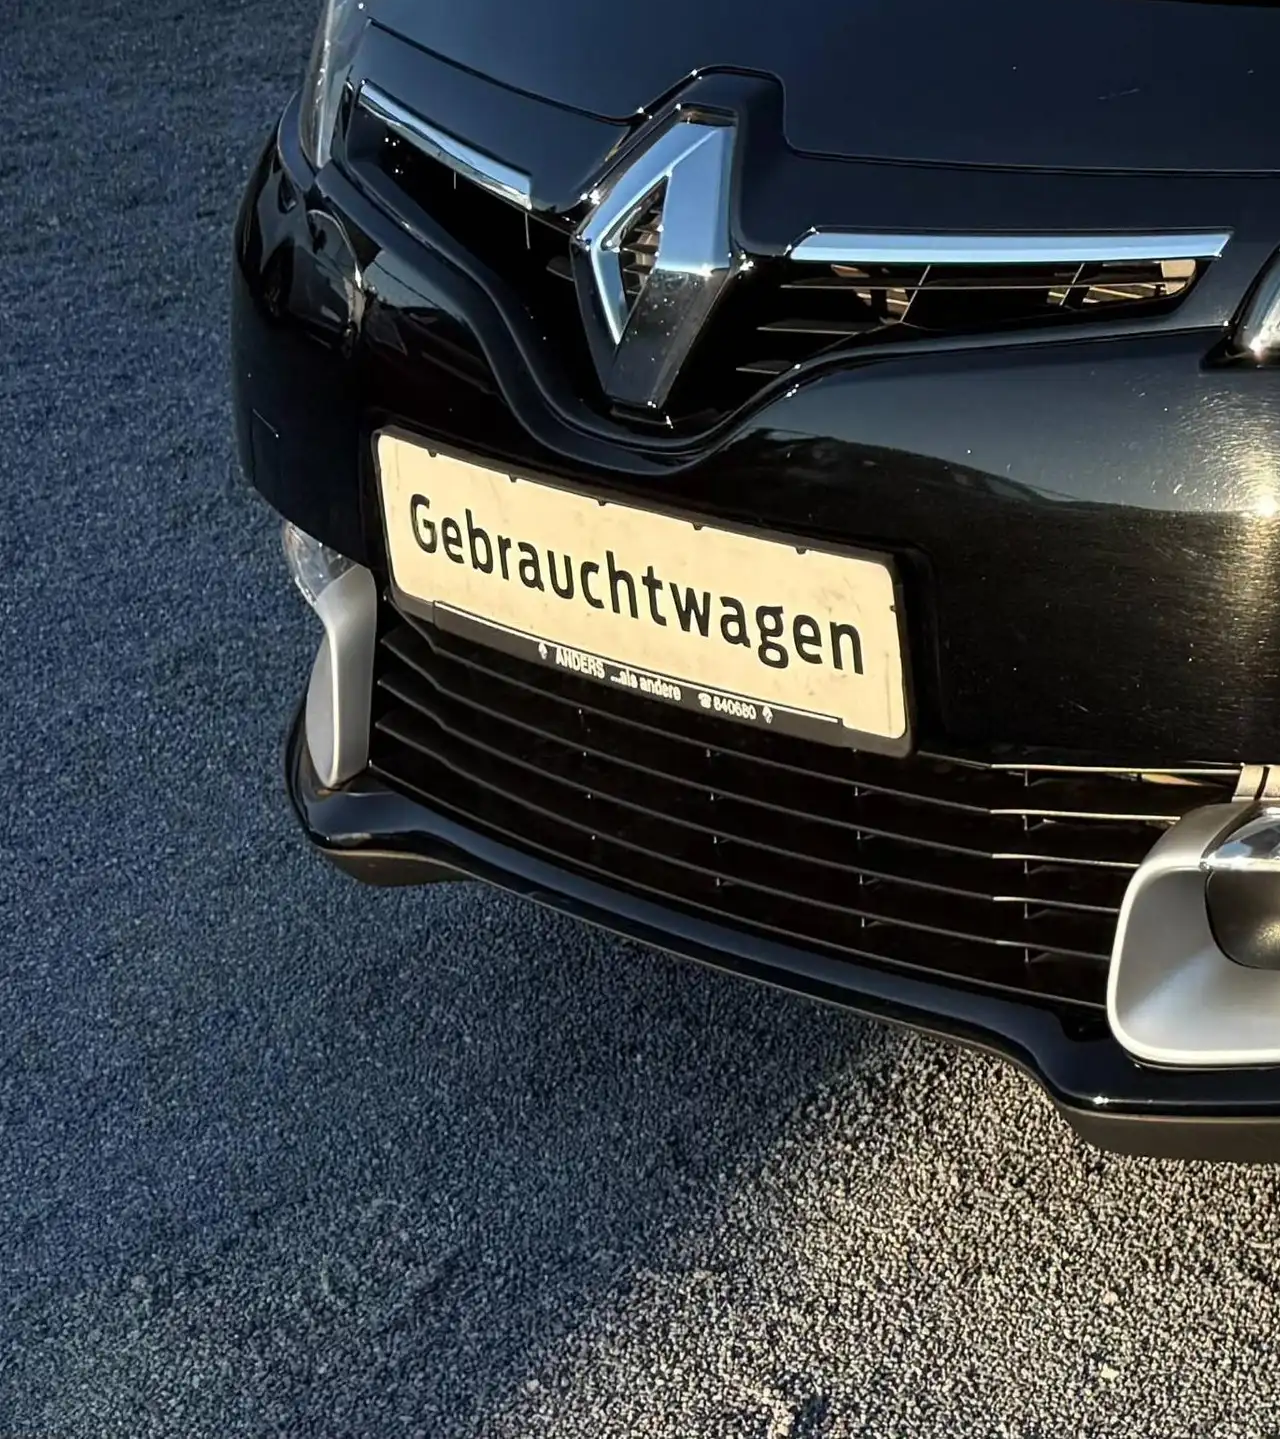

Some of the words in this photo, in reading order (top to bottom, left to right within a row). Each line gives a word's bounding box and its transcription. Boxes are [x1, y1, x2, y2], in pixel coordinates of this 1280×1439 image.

[409, 493, 864, 675] Gebrauchtwagen
[555, 646, 605, 679] ANDERS
[640, 676, 681, 701] andere
